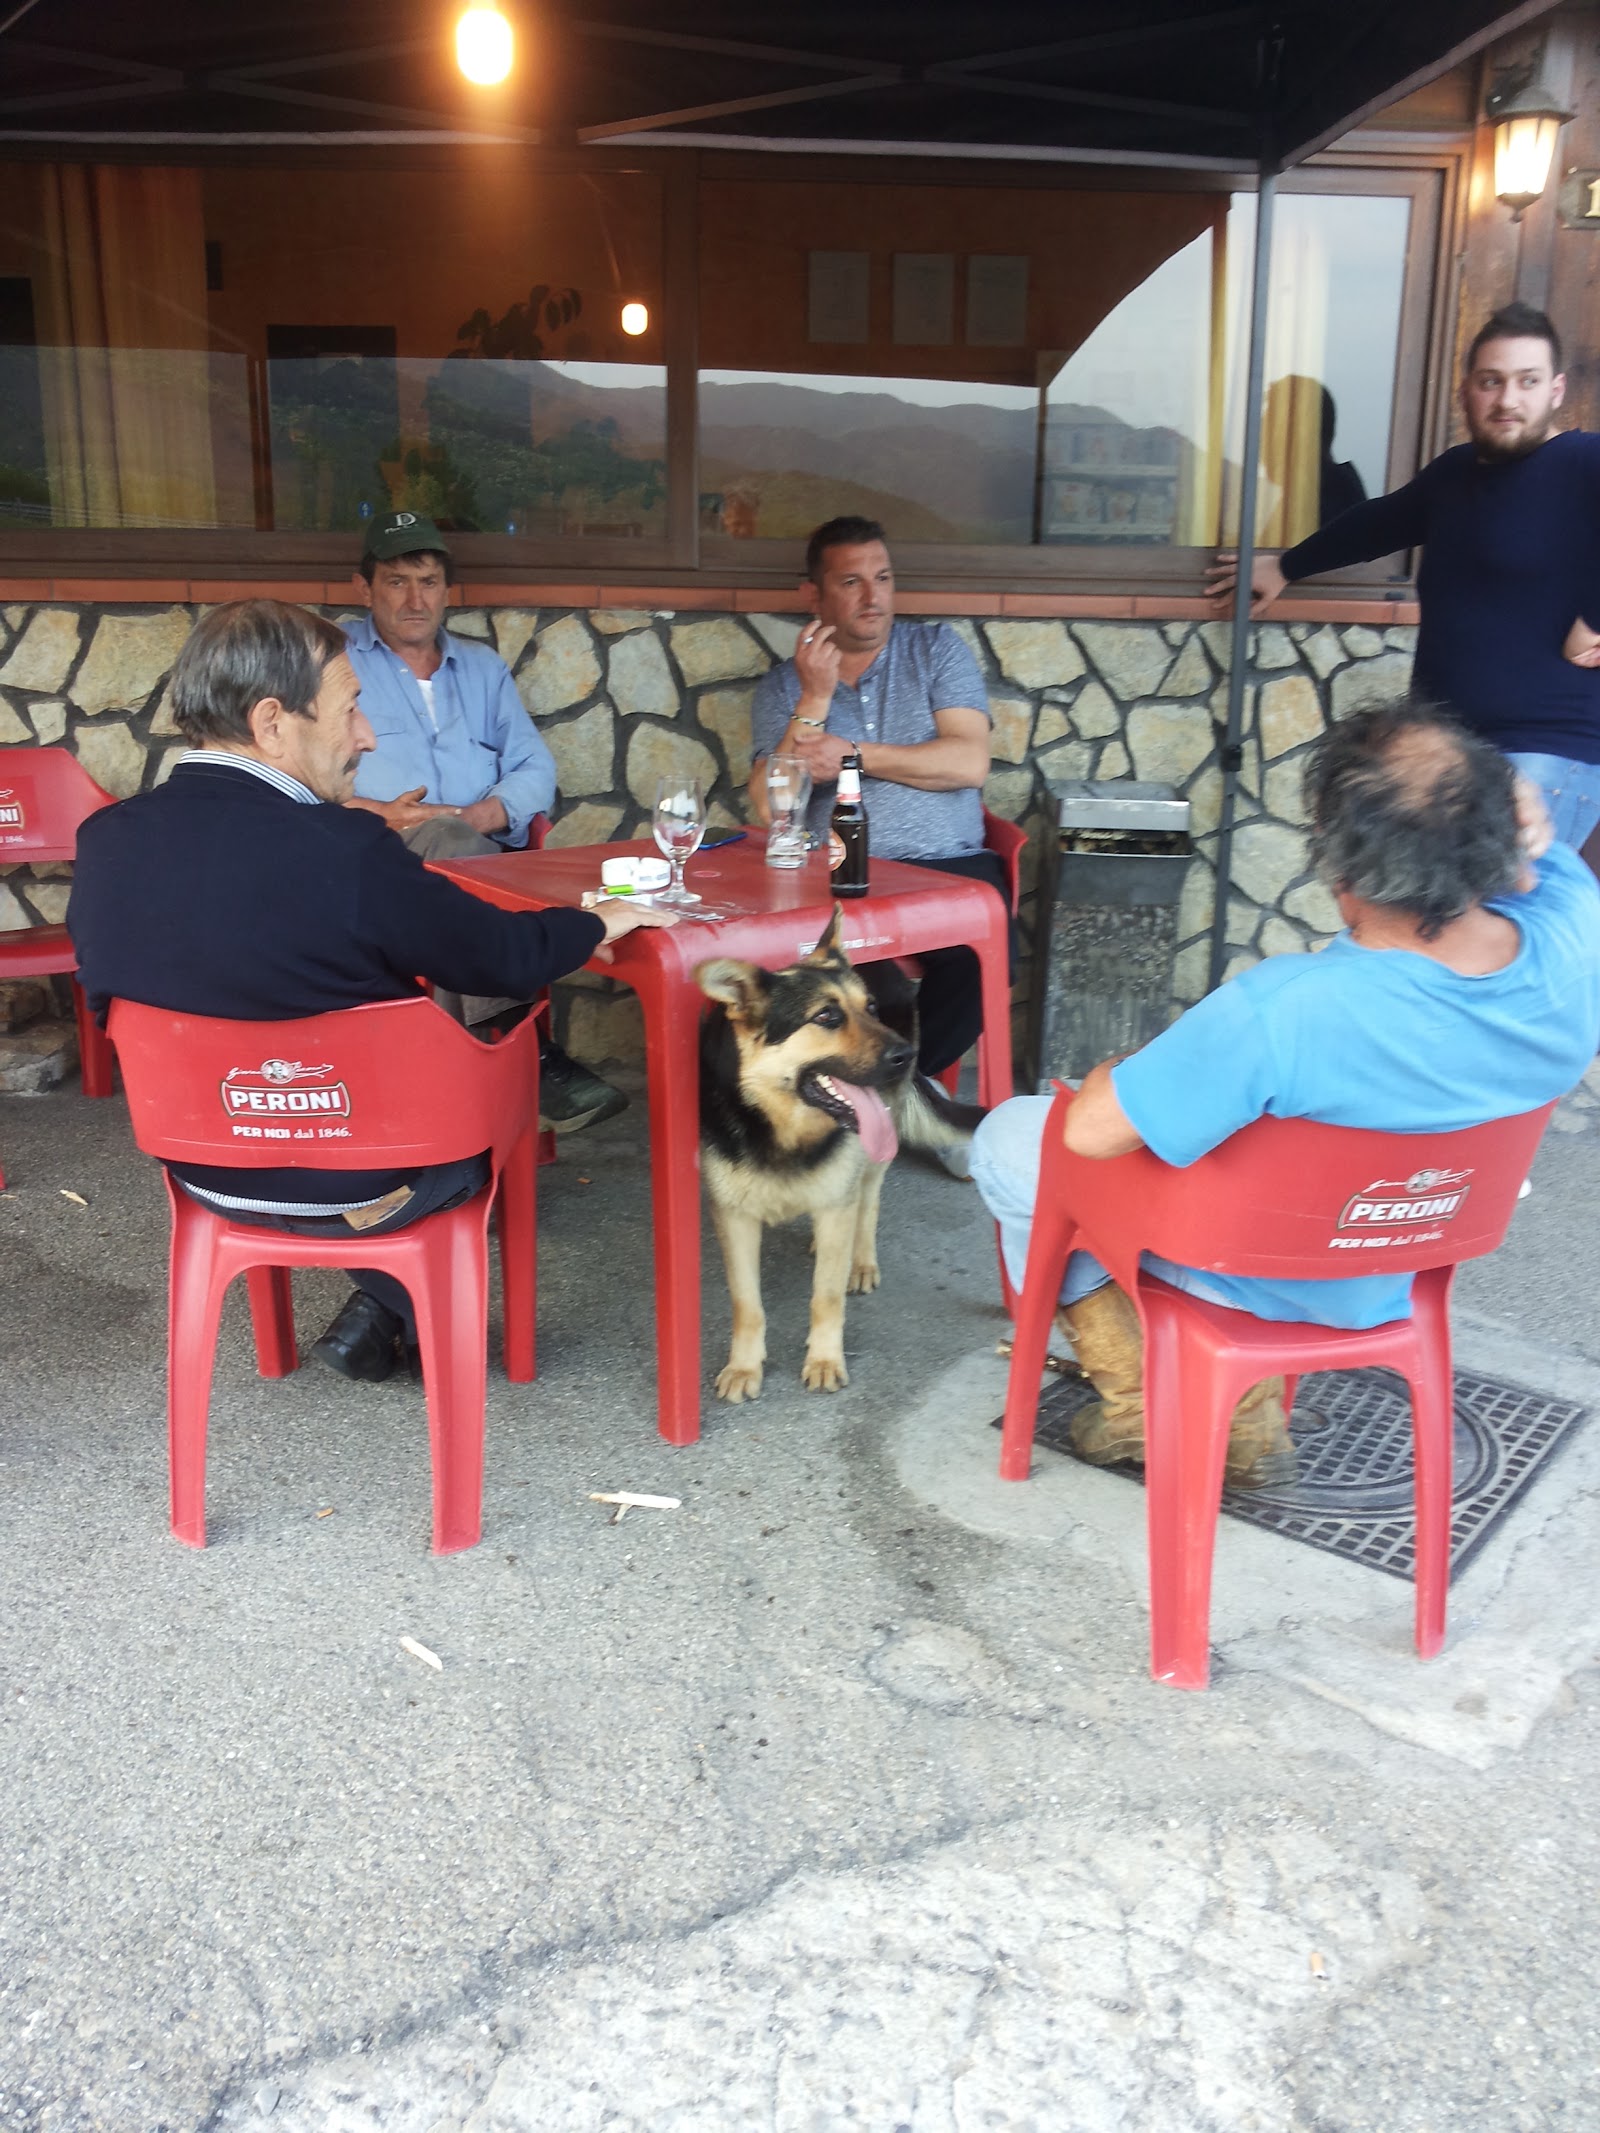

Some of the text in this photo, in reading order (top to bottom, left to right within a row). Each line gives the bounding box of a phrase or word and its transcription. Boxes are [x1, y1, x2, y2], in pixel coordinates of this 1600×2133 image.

[229, 1090, 341, 1111] PERONI
[232, 1125, 352, 1138] PER NOI dal 1846.
[1349, 1195, 1461, 1221] PERONI
[1328, 1237, 1363, 1248] PER
